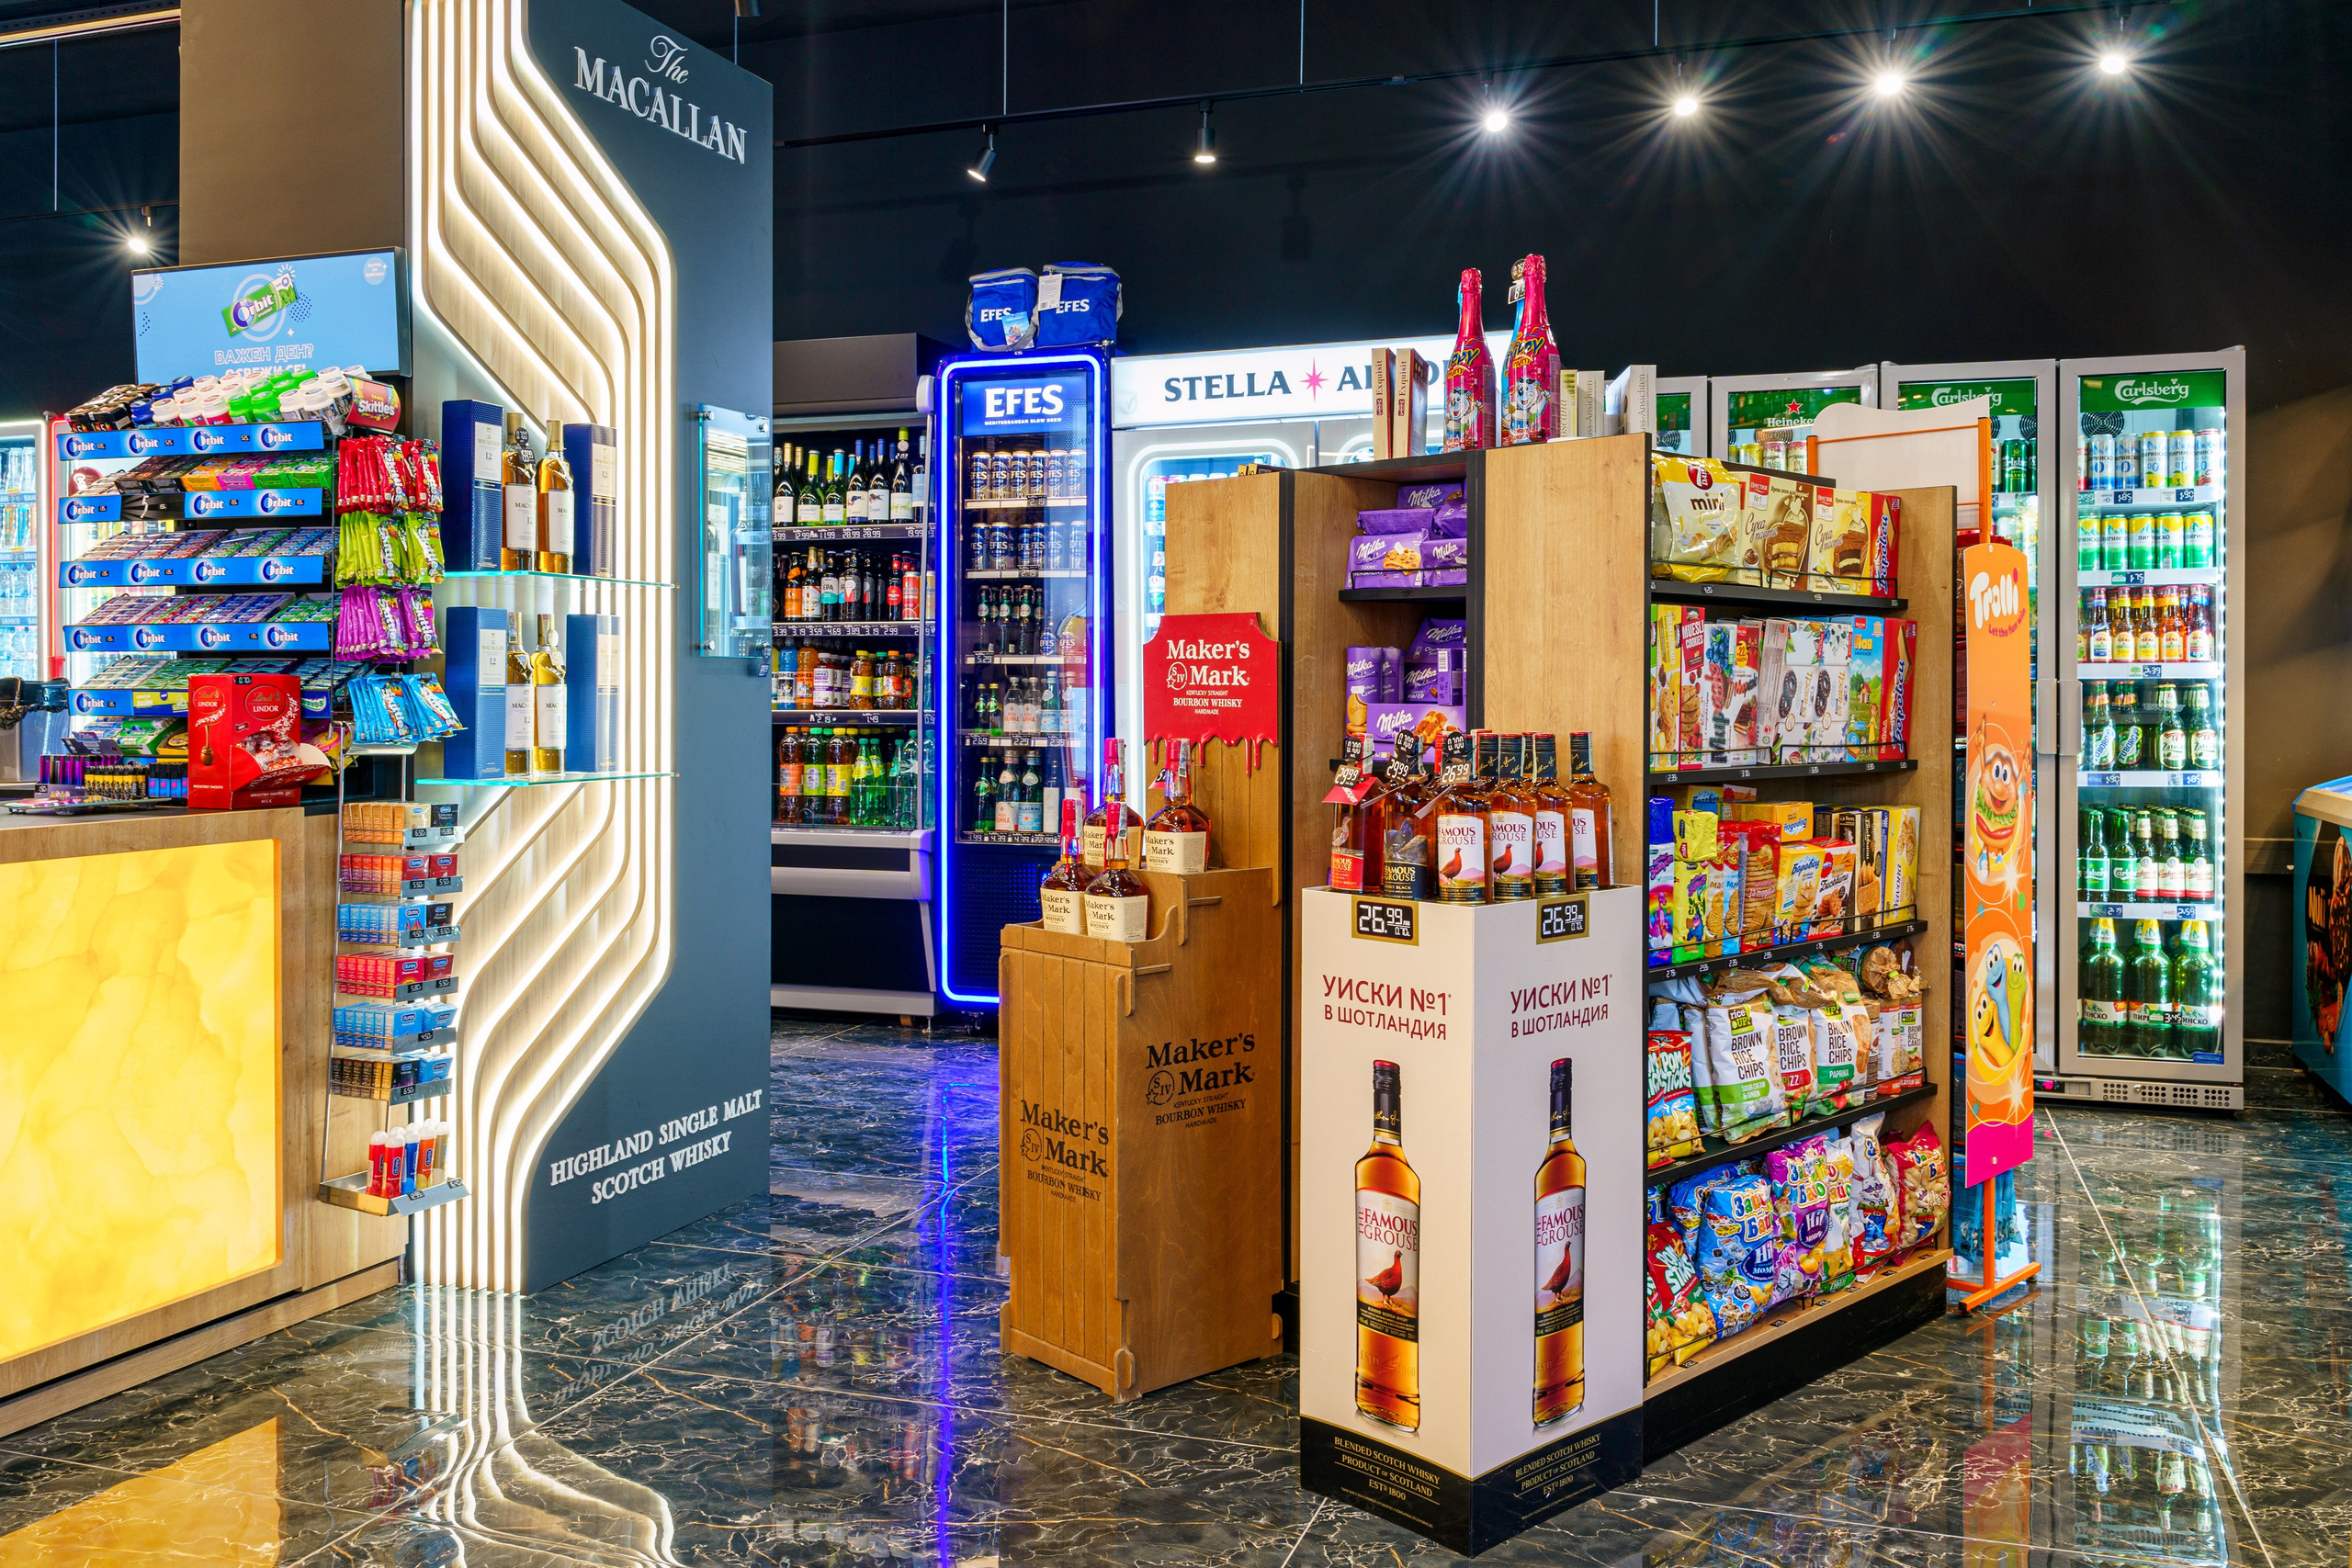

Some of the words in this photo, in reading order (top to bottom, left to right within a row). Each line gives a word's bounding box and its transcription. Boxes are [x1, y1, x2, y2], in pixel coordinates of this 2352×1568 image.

[644, 35, 688, 85] The
[573, 46, 748, 164] MACALLAN
[232, 293, 275, 328] Orbit
[1056, 299, 1090, 314] EFES
[214, 346, 272, 366] ВАЖЕН
[275, 343, 314, 363] ДЕН?
[1164, 370, 1292, 402] STELLA
[1399, 360, 1408, 397] Exquisit
[985, 384, 1064, 419] EFES
[2114, 378, 2190, 405] Carlsberg
[357, 399, 396, 417] Skittles
[66, 437, 96, 457] Orbit
[129, 434, 159, 454] Orbit
[194, 431, 224, 451] Orbit
[261, 427, 293, 448] Orbit
[485, 452, 492, 460] 12
[1750, 481, 1769, 491] ПРЕСТИЖ
[193, 494, 224, 514] Orbit
[261, 493, 292, 513] Orbit
[1408, 487, 1442, 507] Milka
[1690, 492, 1725, 512] mini
[66, 501, 96, 521] Orbit
[1355, 538, 1387, 559] Milka
[1432, 542, 1459, 560] Milka
[68, 564, 97, 584] Orbit
[130, 562, 161, 582] Orbit
[196, 561, 227, 581] Orbit
[263, 560, 294, 581] Orbit
[1969, 567, 2019, 629] Trolli
[1682, 620, 1704, 639] MUESLI
[1988, 623, 1999, 636] Let
[1999, 626, 2008, 637] the
[2008, 624, 2018, 636] fun
[2018, 607, 2027, 625] win
[73, 629, 102, 649] Orbit
[135, 628, 165, 649] Orbit
[200, 627, 232, 648] Orbit
[267, 626, 300, 647] Orbit
[1426, 625, 1464, 643] Milka
[1685, 635, 1704, 649] COOKIES
[1166, 639, 1250, 660] Maker's
[1177, 673, 1185, 682] IV
[1189, 665, 1250, 686] Mark
[1346, 660, 1374, 680] Milka
[1404, 667, 1438, 685] Milka
[76, 694, 106, 714] Orbit
[253, 705, 279, 713] LINDOR
[1173, 697, 1209, 707] BOURBON
[1211, 698, 1242, 708] WHISKY
[1376, 709, 1414, 734] Milka
[2119, 733, 2139, 762] TUBORG
[1145, 835, 1174, 845] Maker's
[1151, 846, 1175, 856] Mark
[1792, 856, 1821, 876] Боровец
[1041, 893, 1070, 905] Maker's
[1047, 904, 1071, 914] Mark
[1085, 900, 1114, 911] Maker's
[1091, 911, 1115, 921] Mark
[1322, 975, 1403, 1010] УИСКИ
[1510, 980, 1577, 1014] УИСКИ
[1324, 1004, 1333, 1021] В
[1338, 1006, 1447, 1041] ШОТЛАНДИЯ
[1511, 1021, 1519, 1039] В
[1522, 1003, 1609, 1036] ШОТЛАНДИЯ
[1730, 1010, 1746, 1020] rice
[1778, 1025, 1807, 1042] BROWN
[1827, 1021, 1853, 1036] BROWN
[1146, 1032, 1256, 1069] Maker's
[1731, 1032, 1762, 1051] BROWN
[1779, 1041, 1801, 1056] RICE
[1828, 1034, 1847, 1050] RICE
[1908, 1039, 1921, 1047] CAKES
[1659, 1050, 1682, 1070] POM
[1732, 1049, 1756, 1066] RICE
[1780, 1054, 1807, 1070] CHIPS
[1828, 1048, 1852, 1064] CHIPS
[1178, 1061, 1254, 1095] Mark
[1659, 1066, 1692, 1096] STICKS
[1737, 1062, 1765, 1080] CHIPS
[1782, 1074, 1804, 1087] PIZZA
[1829, 1068, 1849, 1078] PAPRIKA
[1741, 1083, 1752, 1092] SOUR
[1753, 1081, 1766, 1090] CREAM
[1173, 1098, 1202, 1109] KENTUCKY
[1203, 1092, 1229, 1103] STRAIGHT
[1020, 1100, 1109, 1145] Maker's
[1155, 1107, 1204, 1126] BOURBON
[1207, 1099, 1247, 1115] WHISKY
[1185, 1117, 1217, 1129] HANDMADE
[550, 1130, 654, 1186] HIGHLAND
[659, 1106, 718, 1145] SINGLE
[723, 1089, 763, 1122] MALT
[592, 1157, 665, 1204] SCOTCH
[669, 1131, 732, 1173] WHISKY
[1045, 1136, 1108, 1179] Mark
[1041, 1165, 1064, 1177] KENTUCKY
[1064, 1171, 1086, 1183] STRAIGHT
[1027, 1169, 1066, 1189] BOURBON
[1067, 1183, 1102, 1202] WHISKY
[1050, 1190, 1077, 1203] HANDMADE
[1364, 1207, 1418, 1237] FAMOUS
[1541, 1203, 1583, 1231] FAMOUS
[1364, 1224, 1418, 1252] GROUSE
[1541, 1220, 1583, 1247] GROUSE
[1656, 1247, 1676, 1268] POM
[1668, 1258, 1696, 1295] STICKS
[1334, 1437, 1373, 1457] BLENDED
[1373, 1450, 1406, 1471] SCOTCH
[1407, 1463, 1441, 1485] WHISKY
[1515, 1457, 1545, 1478] BLENDED
[1546, 1445, 1573, 1463] SCOTCH
[1574, 1433, 1600, 1450] WHISKY
[1341, 1454, 1381, 1475] PRODUCT
[1389, 1472, 1433, 1497] SCOTLAND
[1521, 1469, 1553, 1491] PRODUCT
[1559, 1450, 1595, 1472] SCOTLAND
[1559, 1474, 1574, 1487] 1800
[1388, 1487, 1407, 1501] 1800
